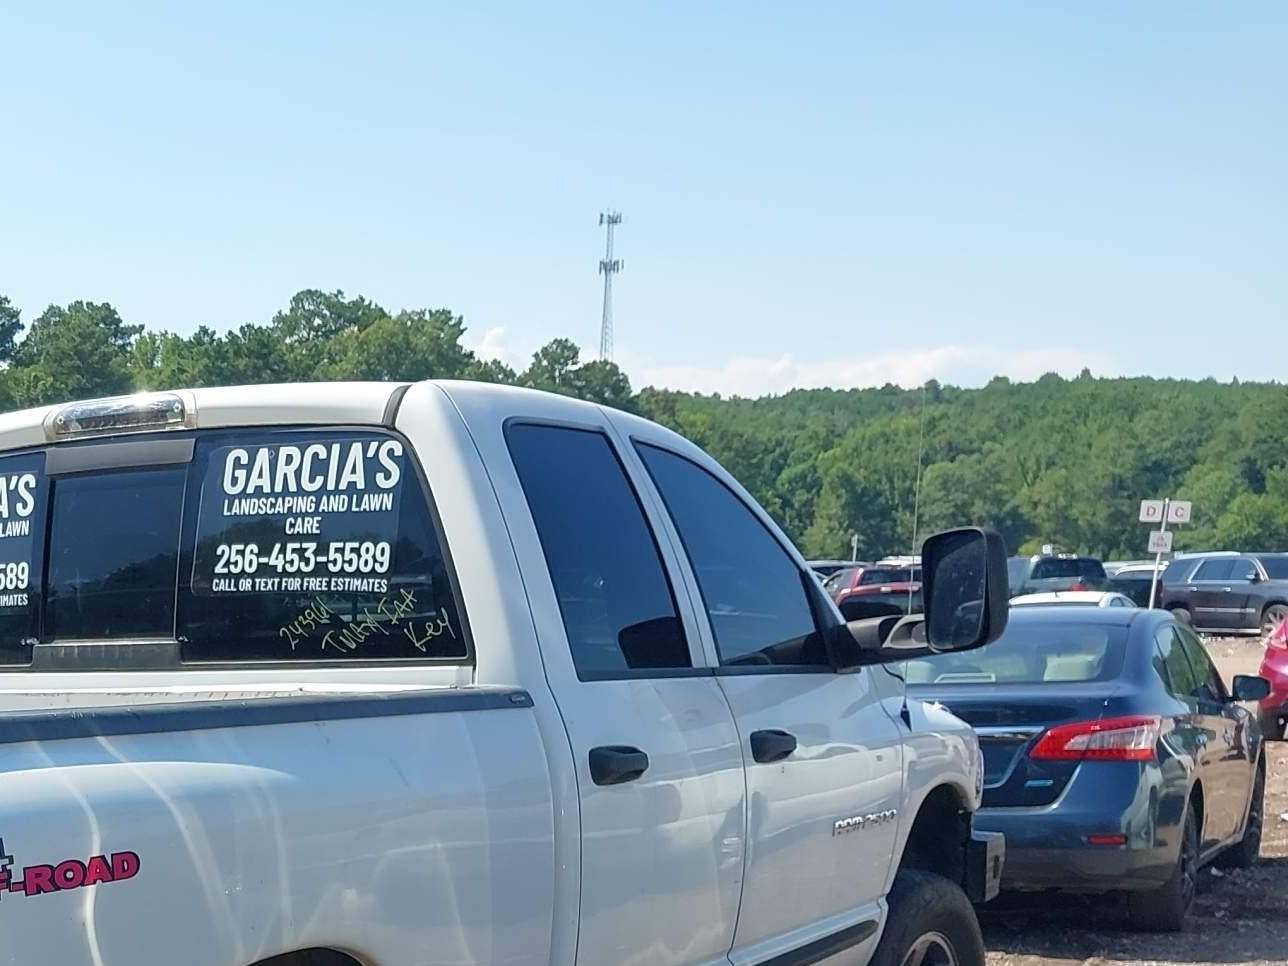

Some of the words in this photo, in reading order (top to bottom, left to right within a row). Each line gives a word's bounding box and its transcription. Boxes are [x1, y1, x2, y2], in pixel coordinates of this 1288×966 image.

[223, 440, 403, 495] GARCIA'S
[224, 495, 316, 516] LANDSCAPING
[319, 494, 348, 513] AND
[352, 493, 393, 512] LAWN
[1146, 505, 1156, 517] D
[0, 520, 29, 538] LAWN
[285, 517, 321, 534] CARE
[214, 541, 391, 574] 256-453-5589
[212, 578, 237, 592] CALL
[238, 578, 251, 591] OR
[254, 578, 280, 591] TEXT
[282, 578, 301, 591] FOR
[303, 577, 328, 591] FREE
[331, 577, 388, 593] ESTIMATES
